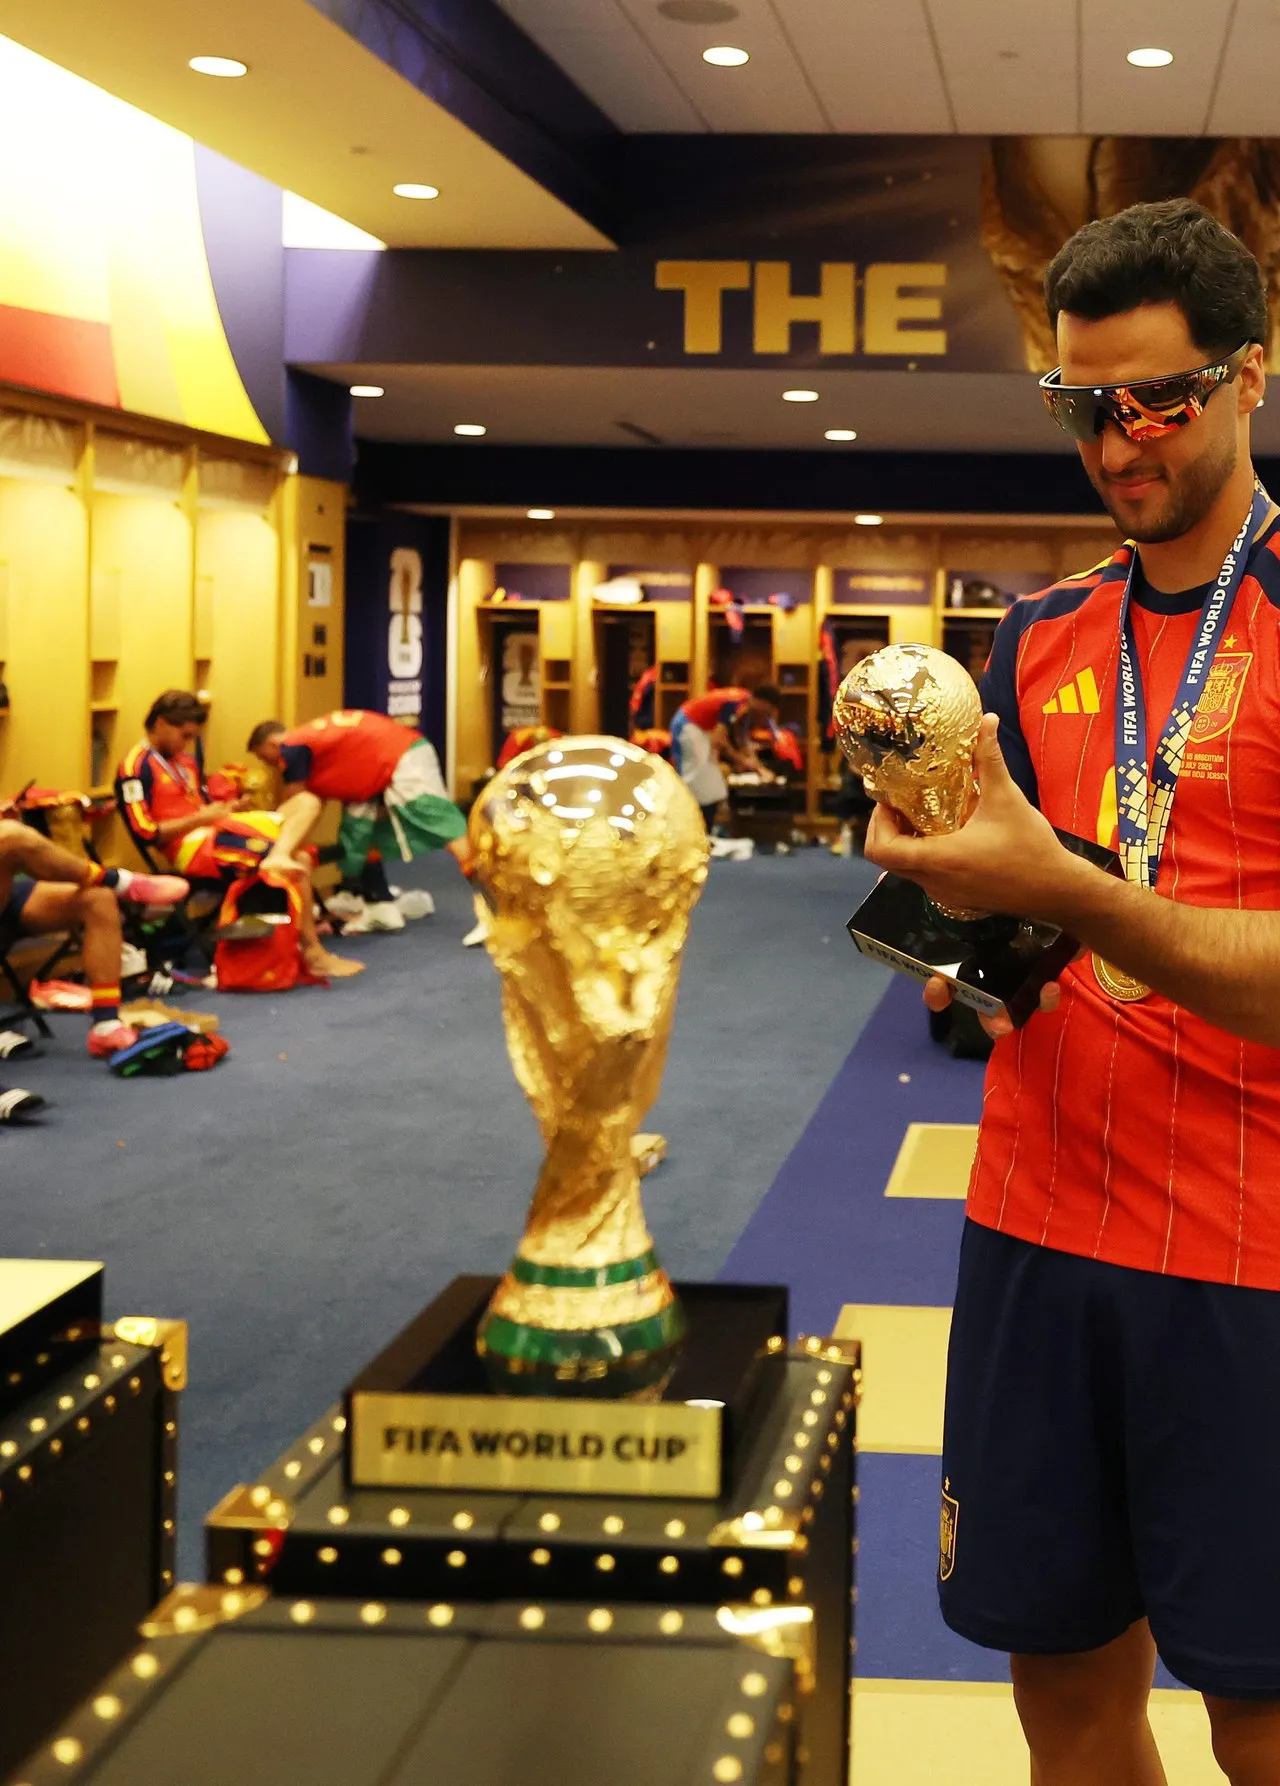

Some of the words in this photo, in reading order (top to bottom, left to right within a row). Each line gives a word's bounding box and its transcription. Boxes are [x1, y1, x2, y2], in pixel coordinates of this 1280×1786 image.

[655, 260, 947, 355] THE
[1187, 649, 1208, 684] FIFA
[1198, 588, 1226, 647] WORLD
[1217, 553, 1237, 587] CUP
[1121, 651, 1136, 707] WORLD
[1123, 711, 1137, 745] FIFA
[1198, 762, 1213, 771] 2026
[384, 1426, 462, 1456] FIFA
[469, 1428, 606, 1461] WORLD
[613, 1433, 688, 1464] CUP
